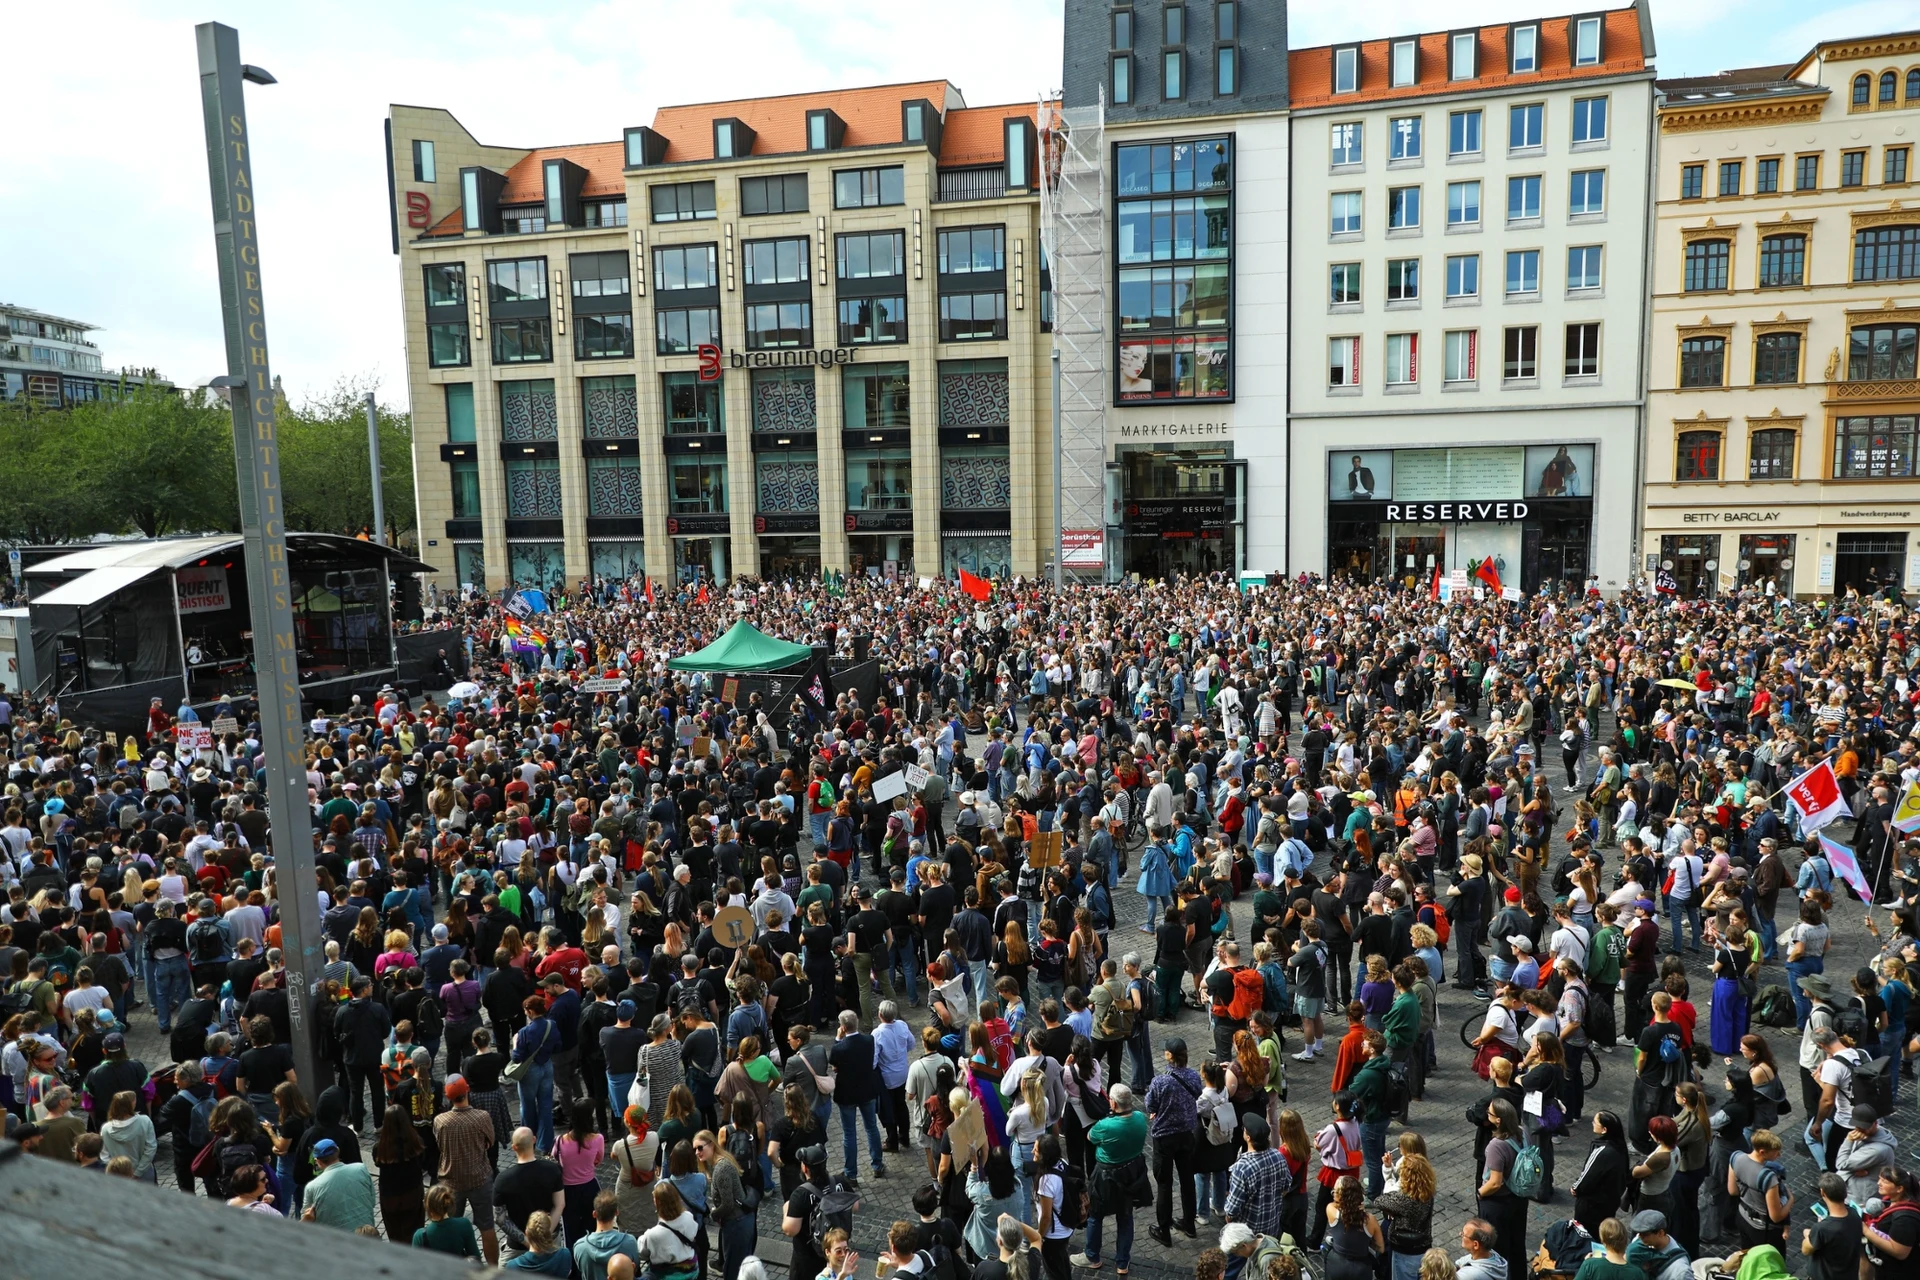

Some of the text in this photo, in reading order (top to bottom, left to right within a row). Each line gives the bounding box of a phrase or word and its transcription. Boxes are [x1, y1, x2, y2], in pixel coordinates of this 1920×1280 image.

[730, 347, 859, 370] breuninger
[1121, 422, 1228, 437] MARKTGALERIE
[229, 115, 307, 768] STADTGESCHICHTLICHES MUSEUM
[1139, 506, 1174, 515] breuninger
[1386, 502, 1529, 521] RESERVED
[1840, 510, 1911, 518] Handwerkerpassage
[1683, 512, 1781, 523] BETTY BARCLAY
[1656, 579, 1677, 590] AFD
[179, 595, 225, 609] HISTISCH
[179, 728, 194, 738] NIE
